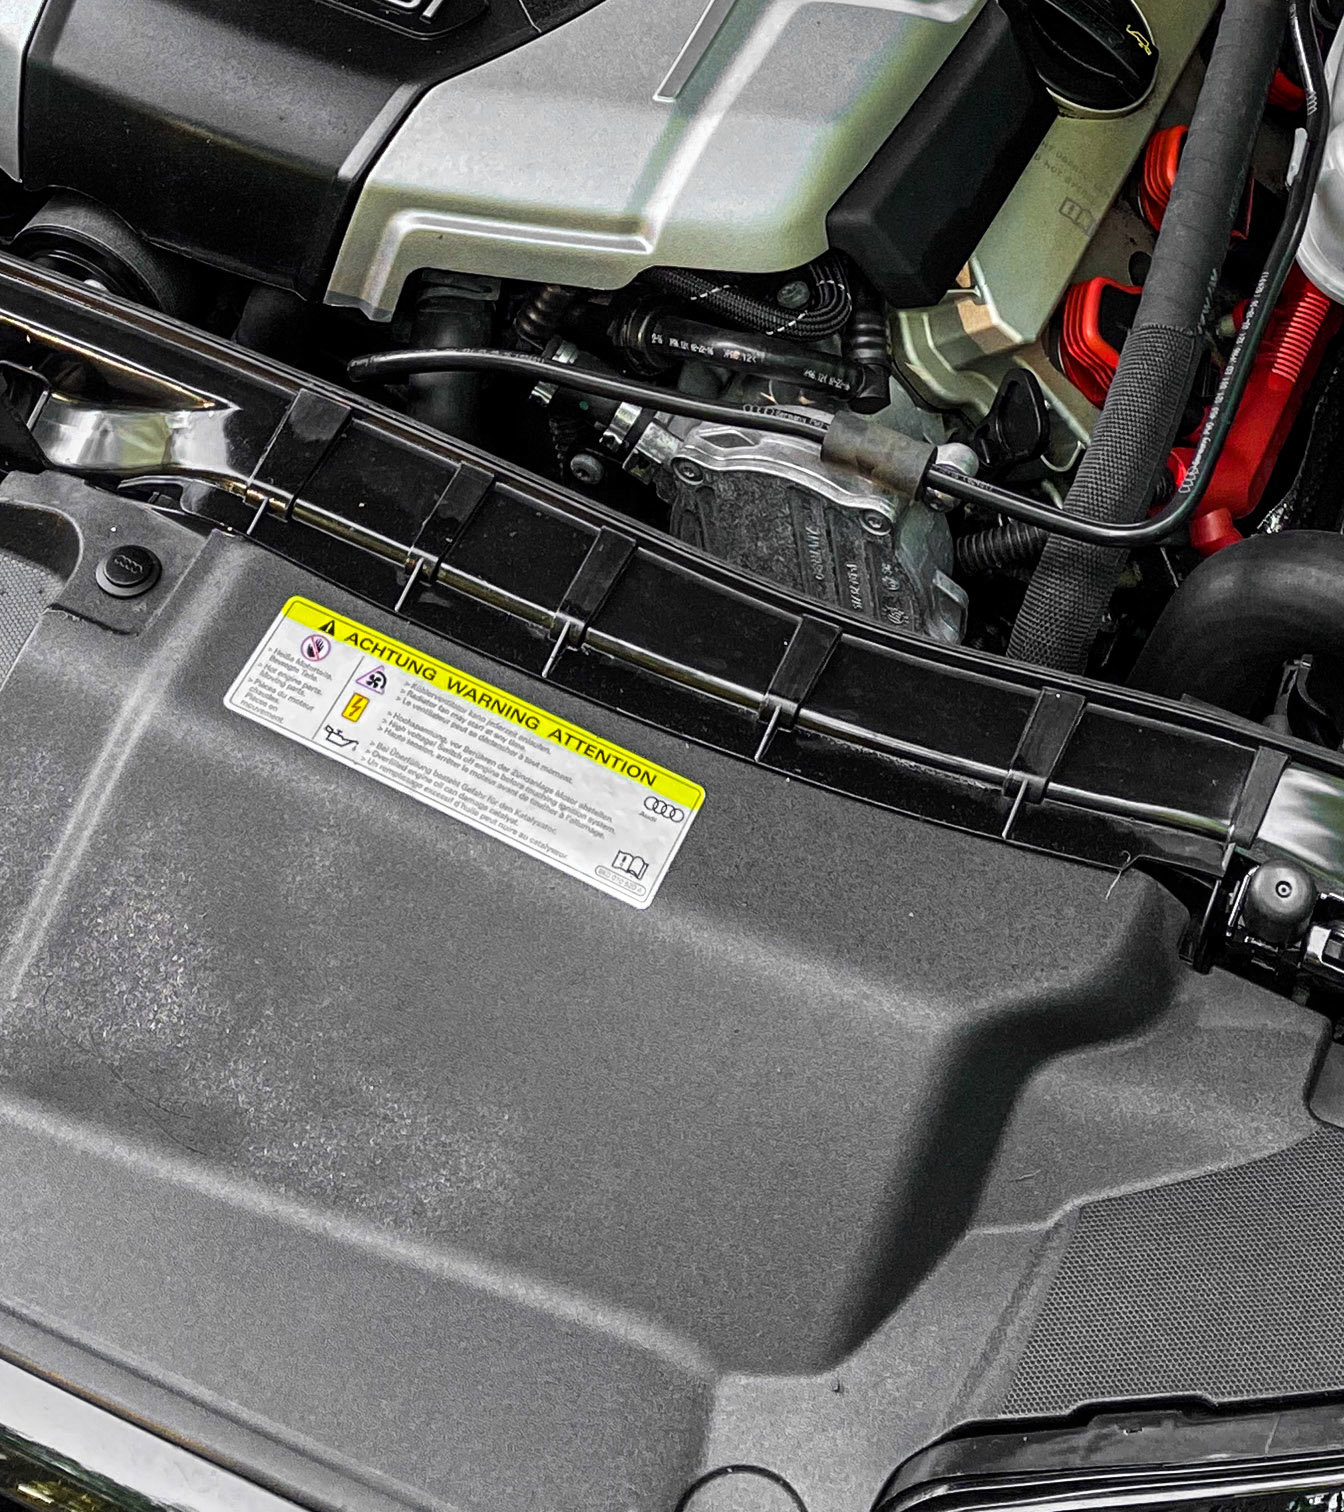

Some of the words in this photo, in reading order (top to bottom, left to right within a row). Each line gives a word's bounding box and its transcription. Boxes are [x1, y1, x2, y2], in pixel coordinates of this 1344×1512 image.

[262, 662, 278, 674] Hot
[275, 669, 303, 687] engine
[275, 689, 288, 699] du
[286, 694, 315, 712] moteur
[342, 631, 440, 681] ACHTUNG
[442, 678, 545, 731] WARNING
[546, 728, 659, 785] ATTENTION
[405, 689, 438, 710] Radiator
[436, 704, 451, 716] fan
[448, 711, 467, 725] may
[466, 718, 485, 732] start
[483, 726, 494, 736] at
[492, 731, 508, 744] any
[386, 719, 407, 734] High
[436, 742, 463, 760] Switch
[461, 754, 475, 766] off
[472, 760, 501, 779] engine
[401, 696, 413, 707] Le
[448, 720, 469, 735] peut
[523, 755, 541, 769] tout
[448, 739, 463, 750] vor
[496, 761, 511, 773] der
[365, 757, 380, 768] Un
[478, 812, 498, 827] peut
[374, 741, 390, 753] Bei
[459, 782, 487, 800] Gefahr
[485, 794, 500, 806] für
[497, 800, 514, 813] den
[405, 767, 433, 786] engine
[432, 778, 445, 790] oil
[442, 784, 458, 797] can
[456, 790, 490, 813] damage
[468, 767, 498, 787] moteur
[496, 781, 519, 797] avant
[517, 791, 530, 803] de
[637, 809, 658, 823] Audi
